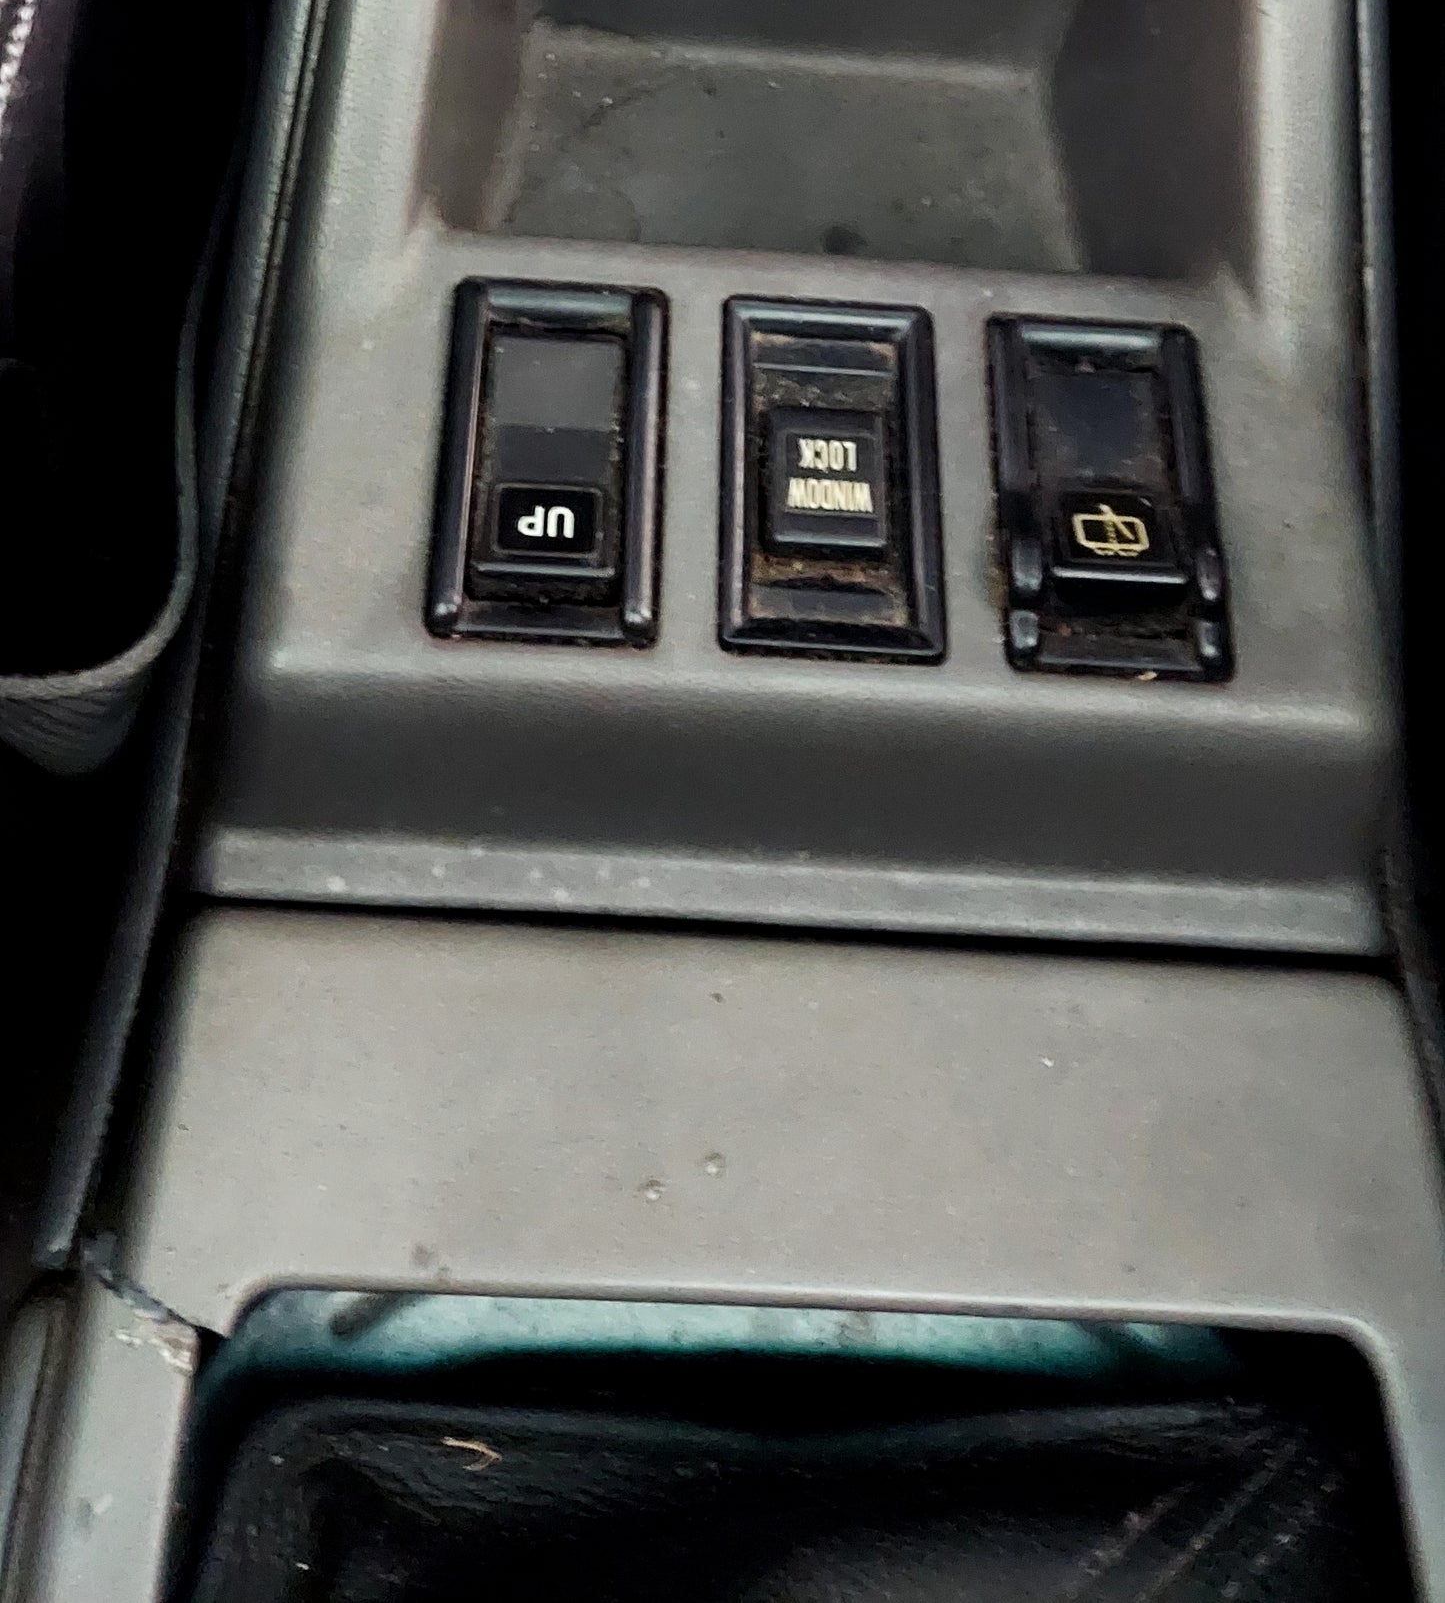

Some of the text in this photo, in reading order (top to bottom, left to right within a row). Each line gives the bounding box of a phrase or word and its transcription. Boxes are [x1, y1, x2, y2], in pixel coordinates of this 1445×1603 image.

[798, 437, 858, 472] LOCK
[786, 477, 873, 513] WINDOW
[517, 504, 575, 539] UP
